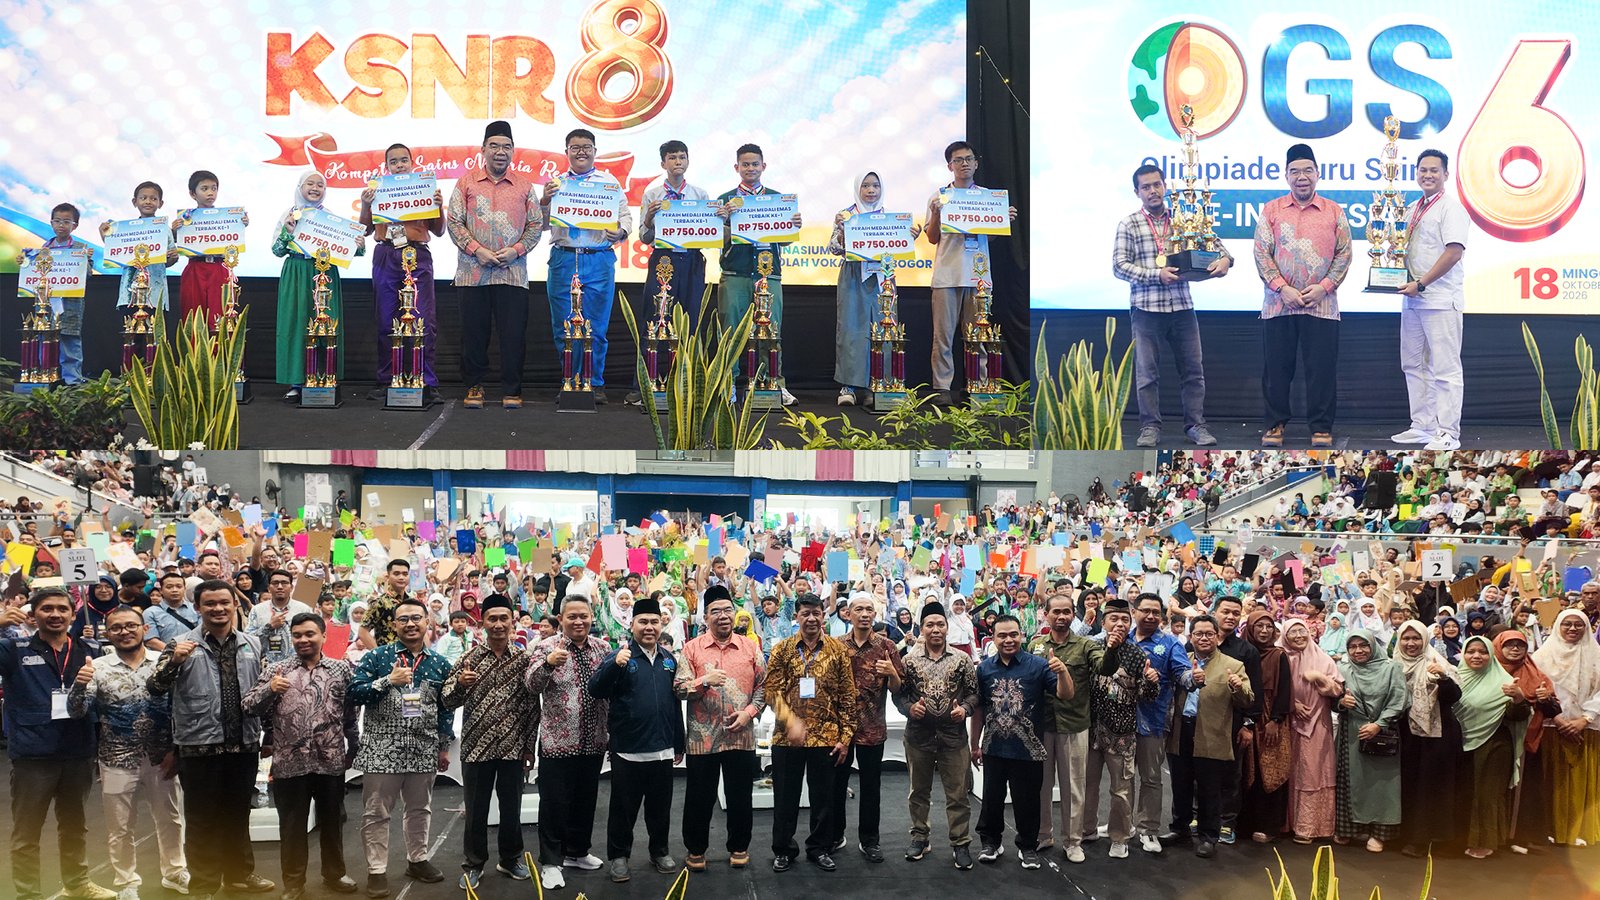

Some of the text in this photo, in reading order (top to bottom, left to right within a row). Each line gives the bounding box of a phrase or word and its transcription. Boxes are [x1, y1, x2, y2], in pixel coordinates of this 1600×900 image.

[265, 0, 674, 131] KSNR 8
[1456, 38, 1587, 243] 6
[413, 154, 459, 174] Sains
[1318, 162, 1355, 181] uru
[378, 198, 432, 211] RP 750.000
[557, 206, 613, 218] RP 750.000
[947, 213, 1004, 224] RP 750.000
[662, 227, 718, 236] RP 750.000
[738, 221, 793, 232] RP 750.000
[184, 233, 239, 244] RP 750.000
[298, 232, 350, 255] RP 750.000
[852, 239, 909, 249] RP 750.000
[110, 243, 161, 256] RP 7500
[26, 276, 38, 285] RP
[1513, 267, 1560, 300] 18
[1562, 290, 1588, 300] 2026
[73, 563, 87, 581] 5
[1431, 562, 1442, 577] 2
